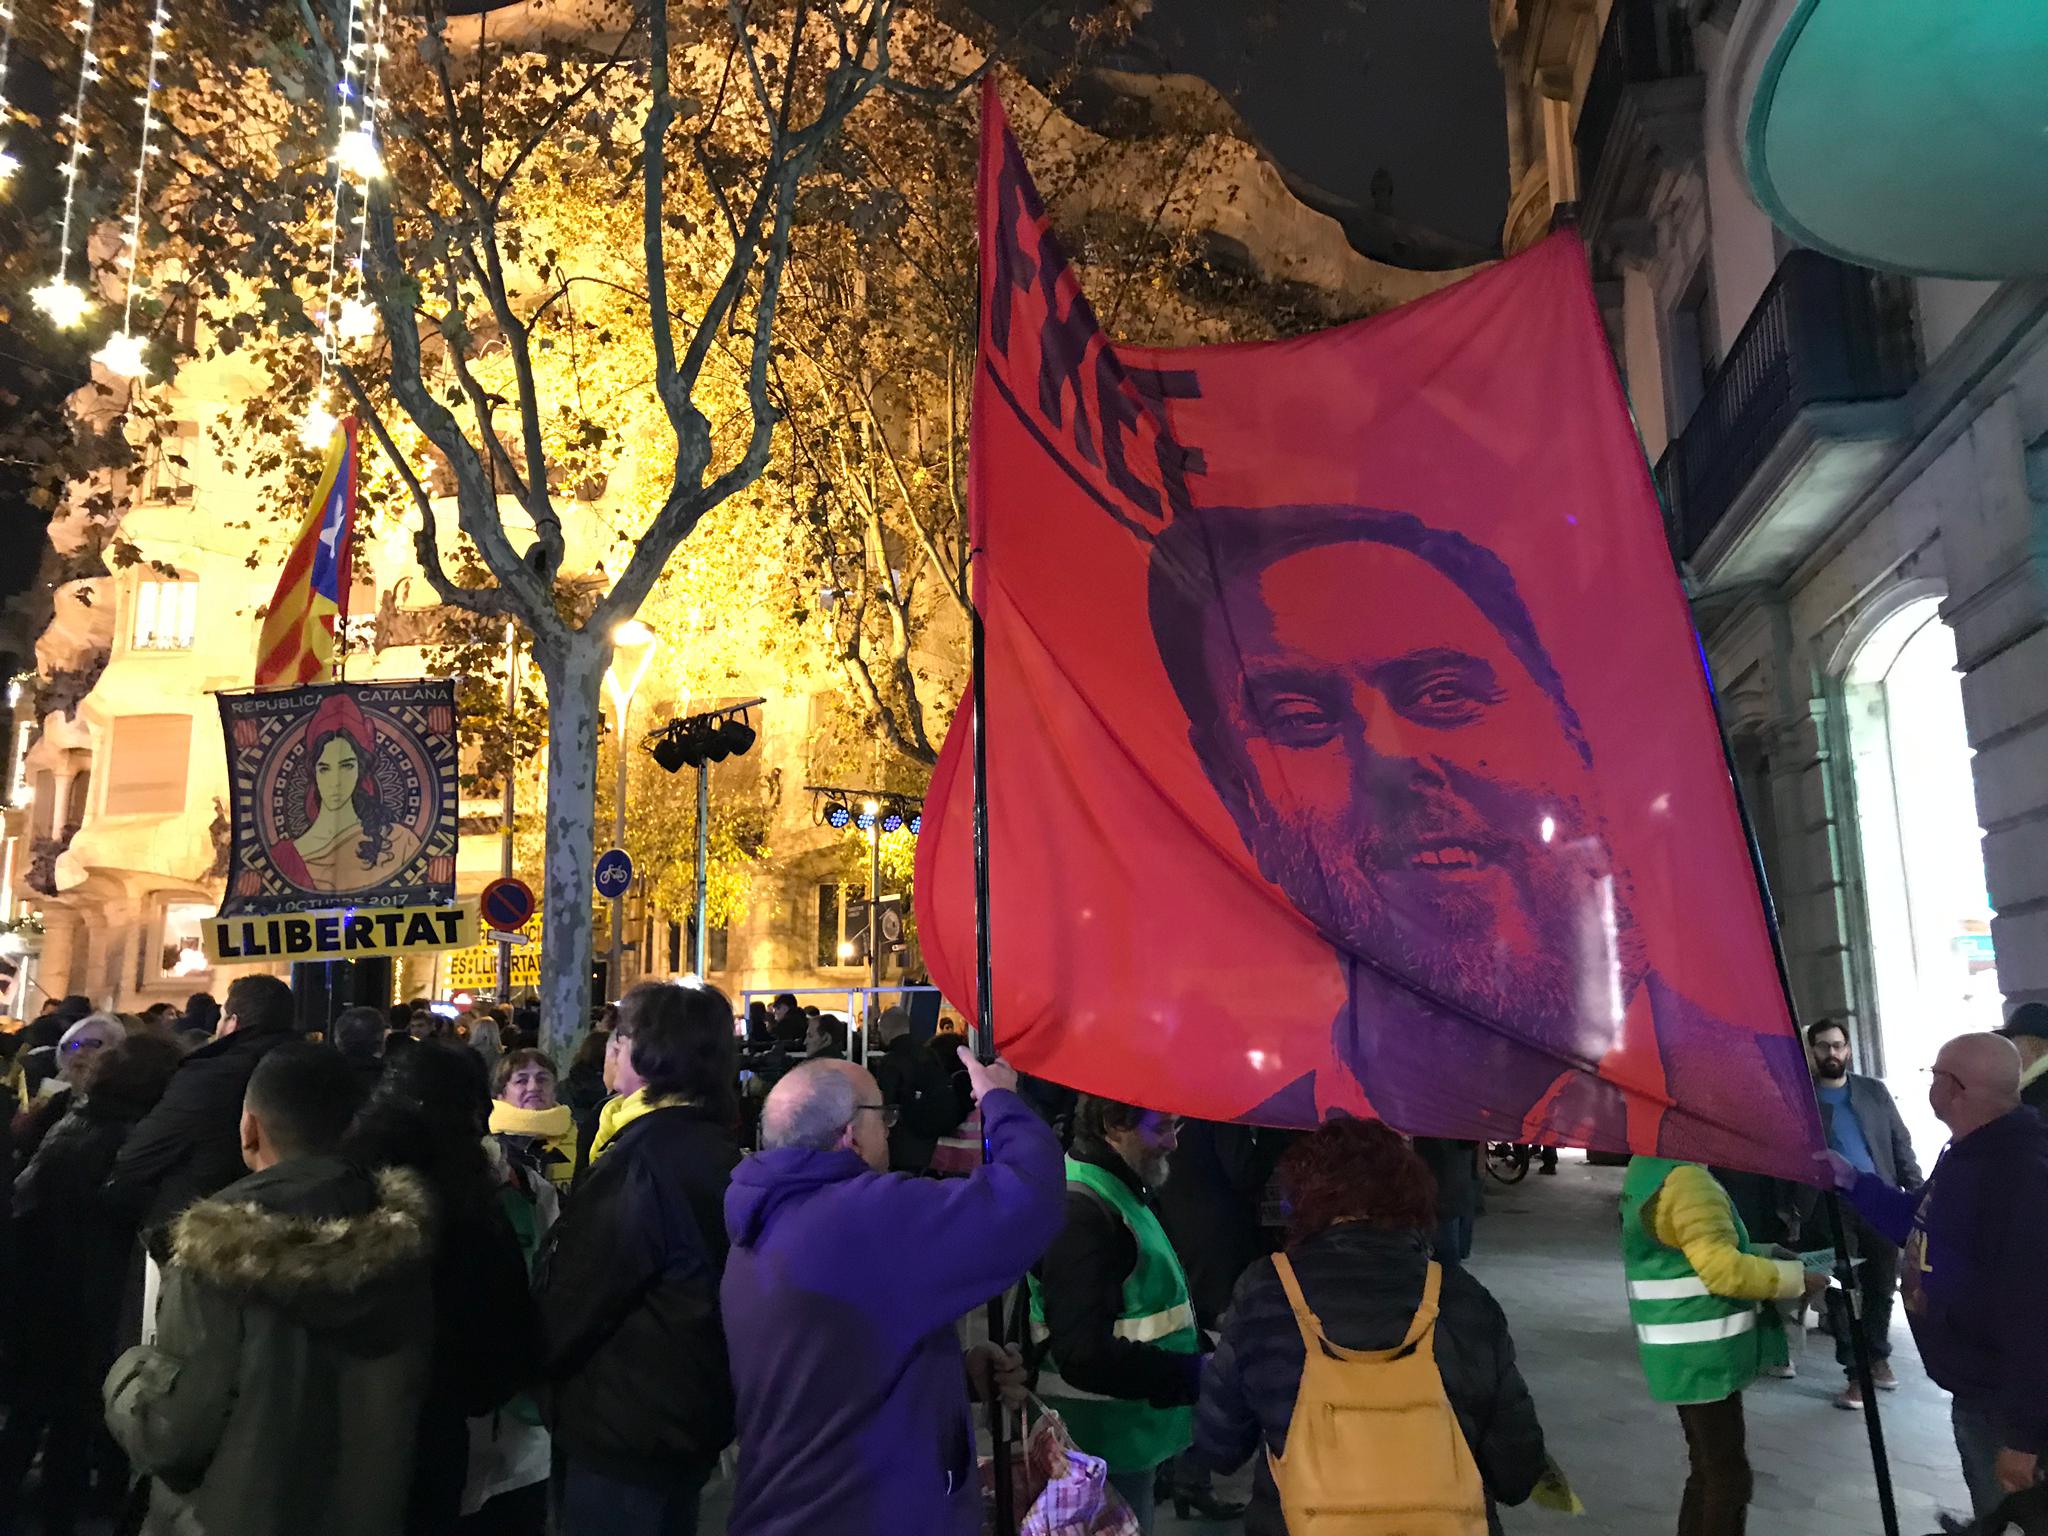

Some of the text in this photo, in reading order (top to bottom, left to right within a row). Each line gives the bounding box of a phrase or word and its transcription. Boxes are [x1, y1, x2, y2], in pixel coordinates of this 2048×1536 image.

[357, 688, 449, 703] CATALANA
[368, 894, 410, 906] 2017
[216, 911, 465, 959] LLIBERTAT
